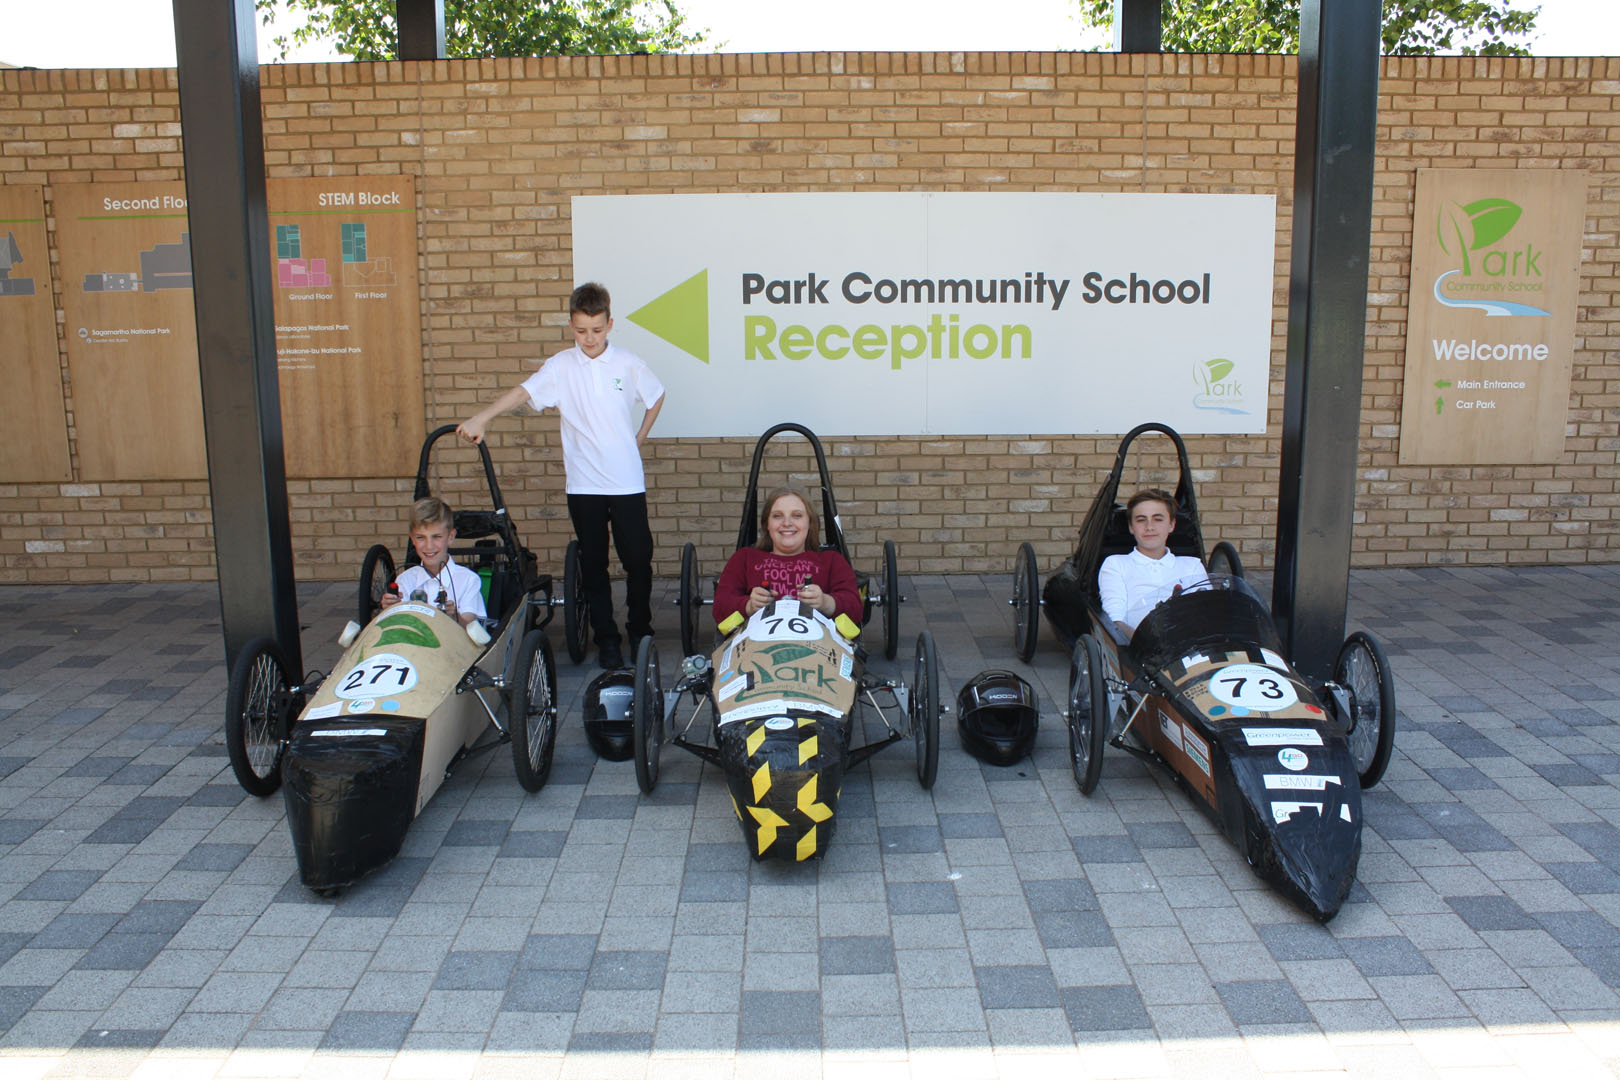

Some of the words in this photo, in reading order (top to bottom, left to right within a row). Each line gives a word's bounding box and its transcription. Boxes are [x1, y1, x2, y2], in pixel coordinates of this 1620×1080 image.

[104, 196, 159, 210] Second
[163, 196, 188, 209] Flo
[319, 193, 355, 206] STEM
[358, 192, 400, 205] Block
[743, 273, 829, 304] Park
[842, 272, 1070, 310] Community
[1083, 272, 1210, 304] School
[1446, 281, 1505, 292] Community
[1508, 281, 1543, 291] School
[745, 314, 1031, 369] Reception
[1433, 339, 1549, 361] Welcome
[1457, 380, 1481, 389] Main
[1484, 380, 1526, 389] Entrance
[1456, 400, 1473, 409] Car
[1476, 400, 1496, 409] Park
[763, 569, 793, 586] FOOL
[765, 618, 809, 635] 76
[343, 665, 410, 691] 271
[1220, 677, 1284, 699] 73
[1280, 776, 1313, 788] BMW
